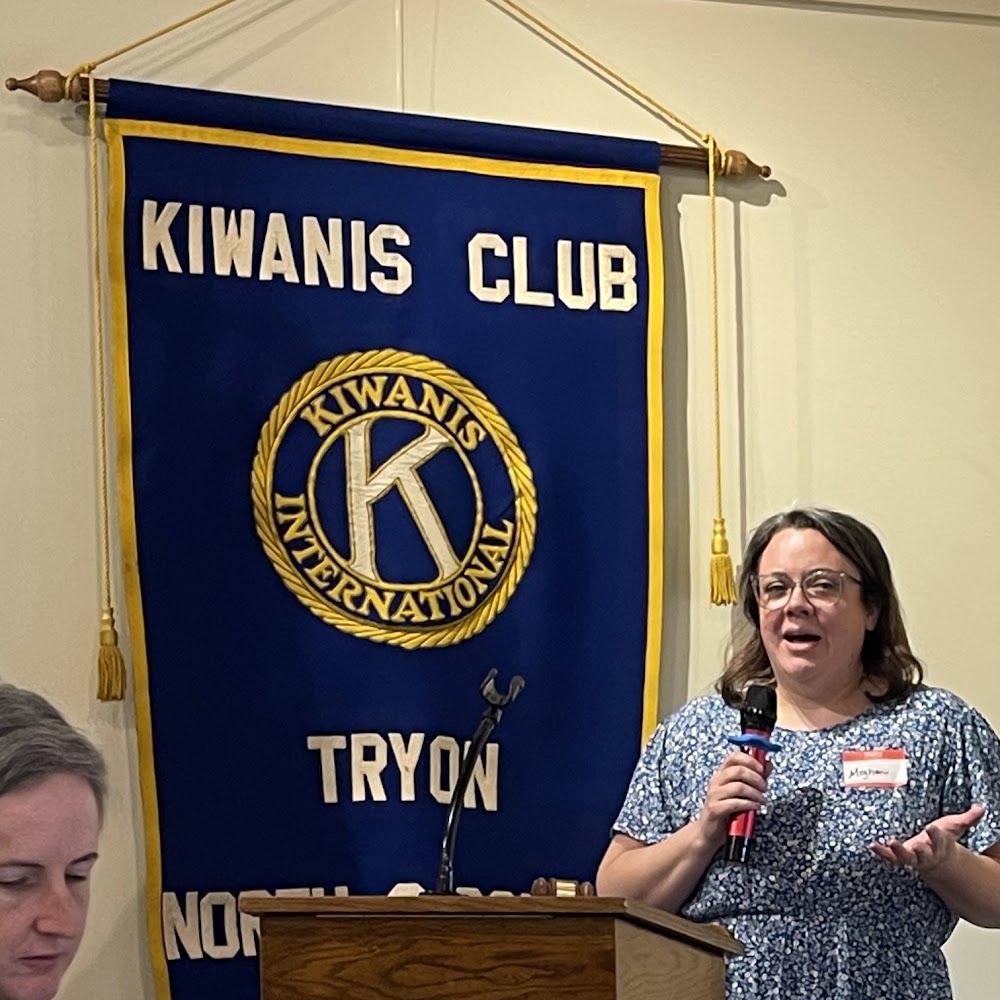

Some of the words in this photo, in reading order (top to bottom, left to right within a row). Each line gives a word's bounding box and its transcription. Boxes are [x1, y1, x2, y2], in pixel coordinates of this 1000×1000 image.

[142, 200, 413, 295] KIWANIS
[468, 233, 638, 312] CLUB
[301, 375, 487, 451] KIWANIS
[344, 418, 462, 584] K
[275, 493, 514, 622] INTERNATIONAL
[306, 732, 499, 812] TRYON
